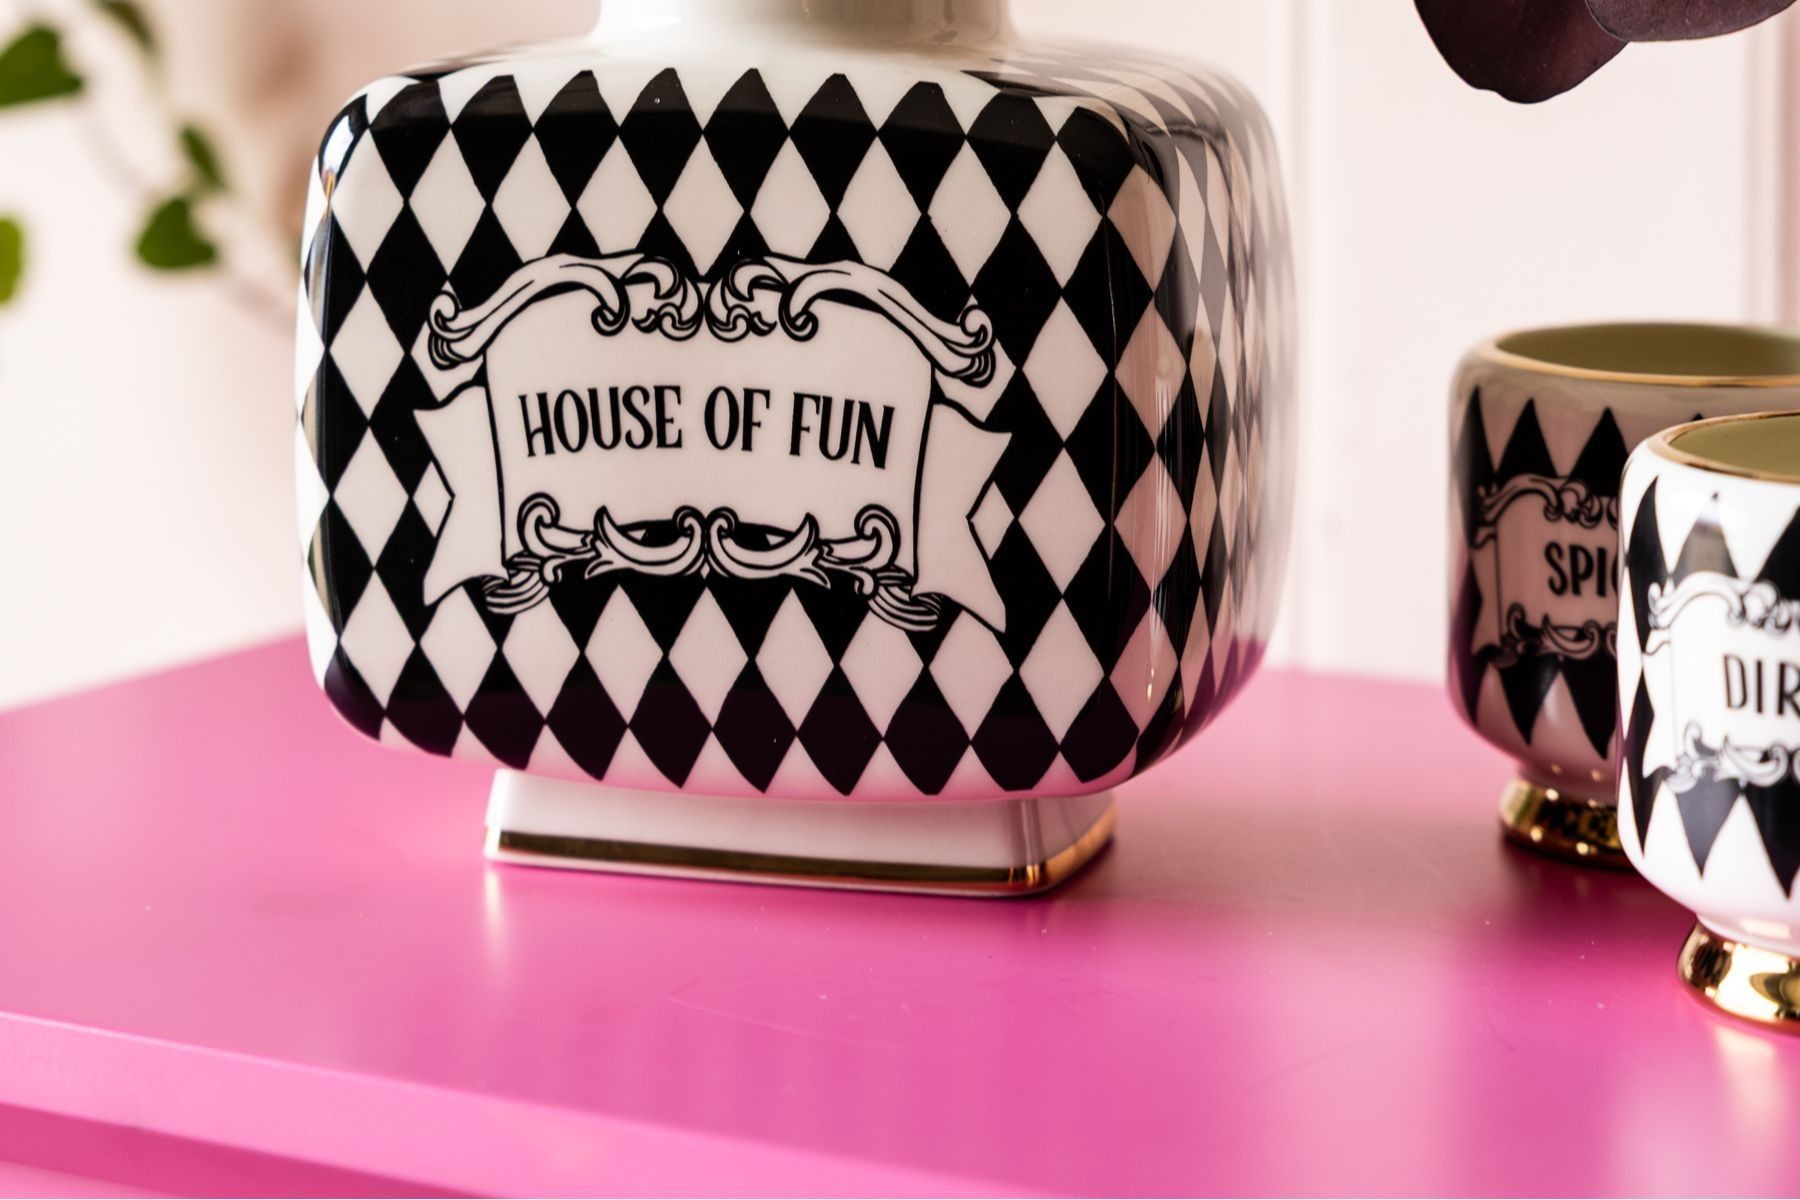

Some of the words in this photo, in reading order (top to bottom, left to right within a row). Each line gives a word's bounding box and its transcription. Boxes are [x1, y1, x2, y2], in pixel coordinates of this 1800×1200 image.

[518, 385, 683, 457] HOUSE
[704, 386, 771, 452] OF
[789, 391, 895, 469] FUN
[1544, 542, 1618, 597] SPI
